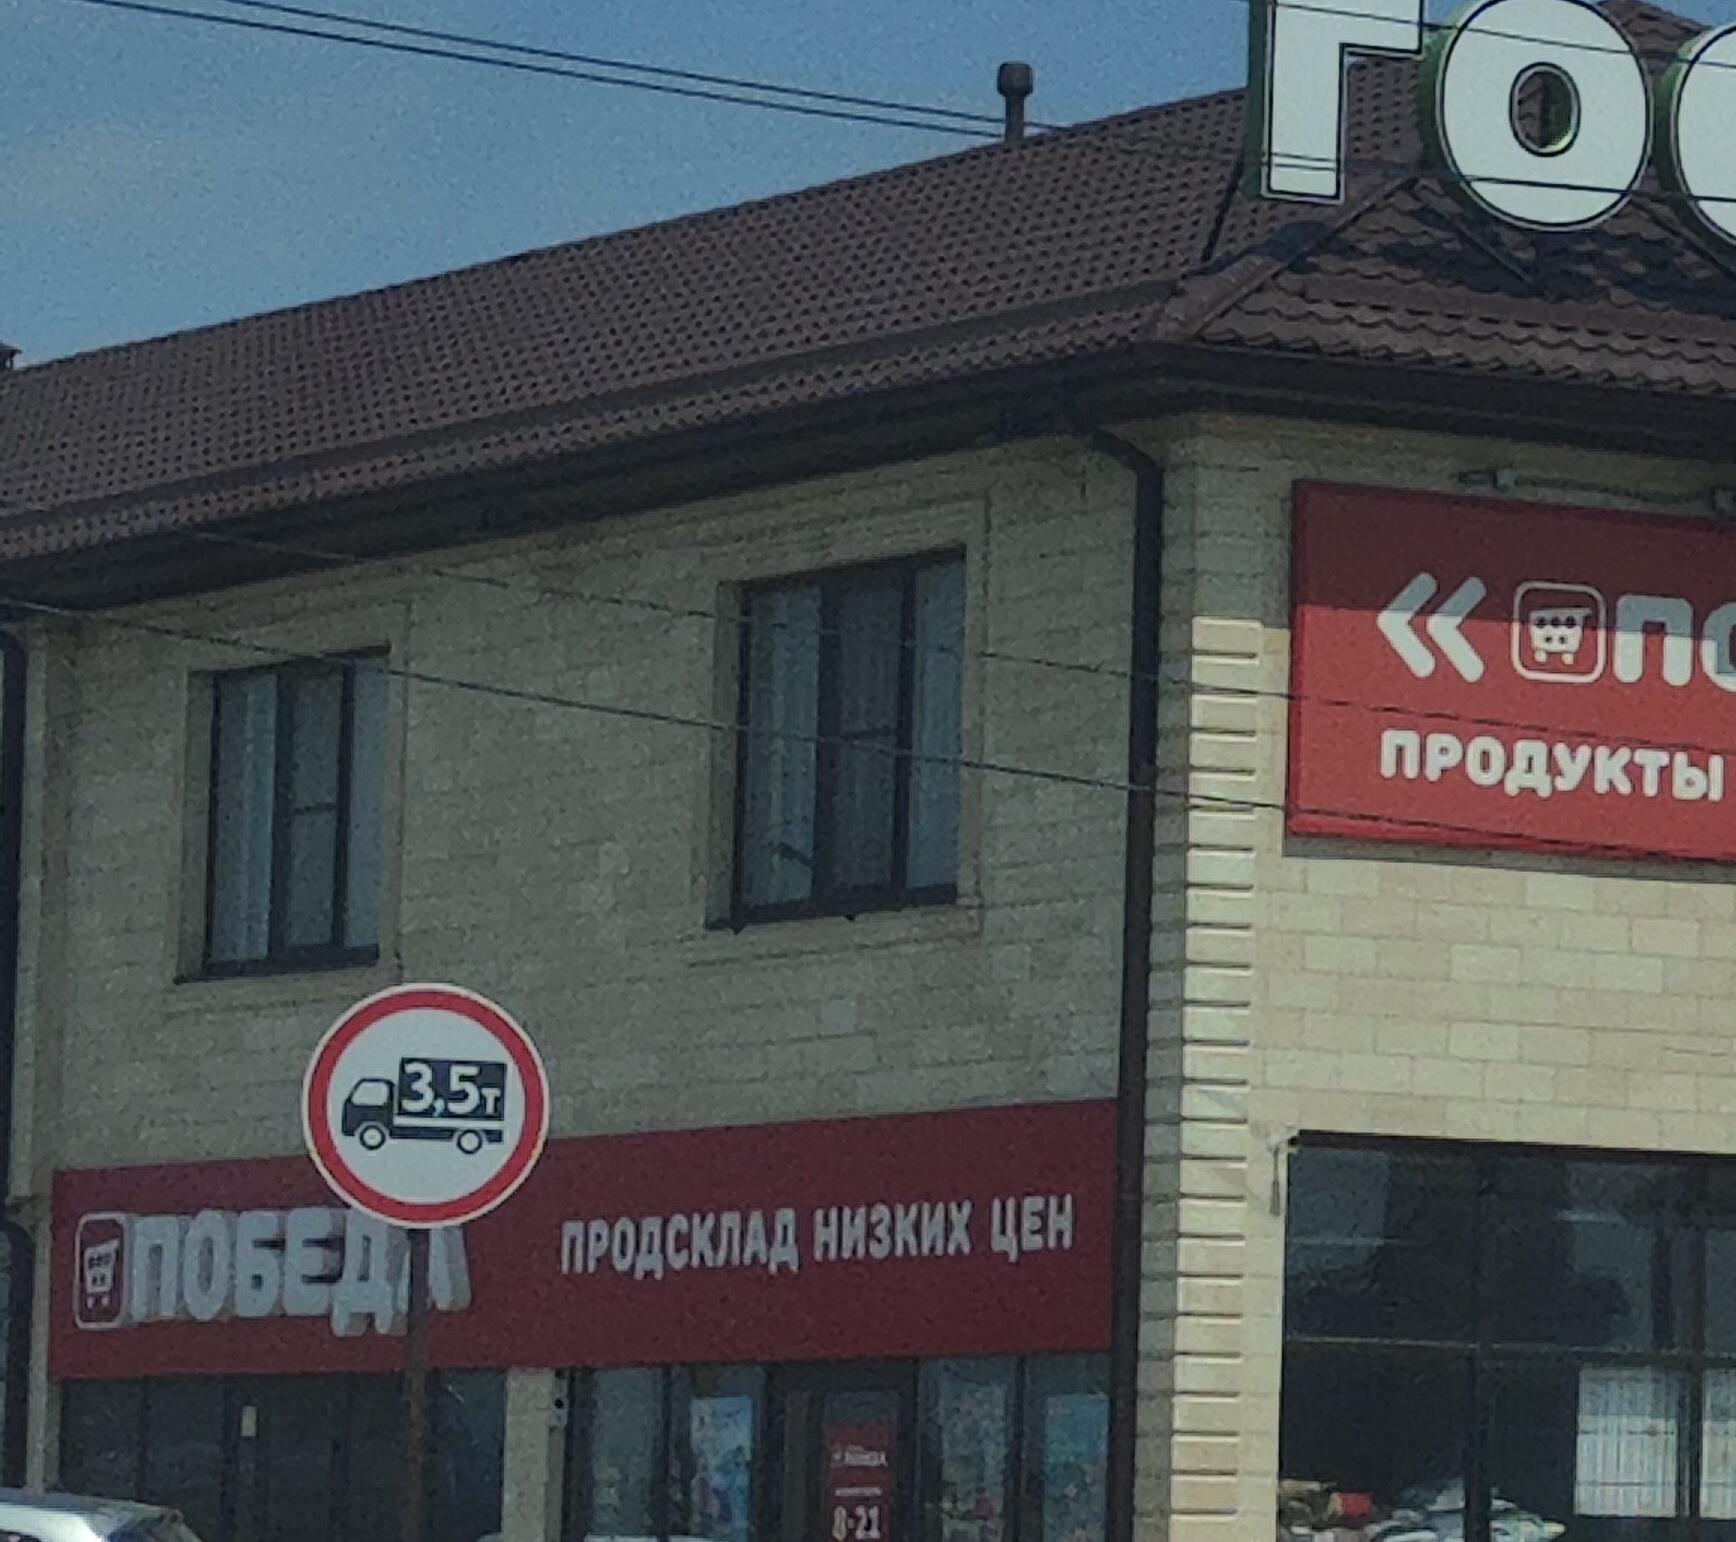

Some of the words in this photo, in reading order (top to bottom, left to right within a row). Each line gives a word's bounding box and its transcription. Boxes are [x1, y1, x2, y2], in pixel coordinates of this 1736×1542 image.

[1379, 729, 1725, 803] ПРОДУКТЫ
[561, 1207, 799, 1281] ПРОДСКЛАД
[813, 1199, 972, 1261] НИЗКИХ
[990, 1192, 1073, 1263] ЦЕН
